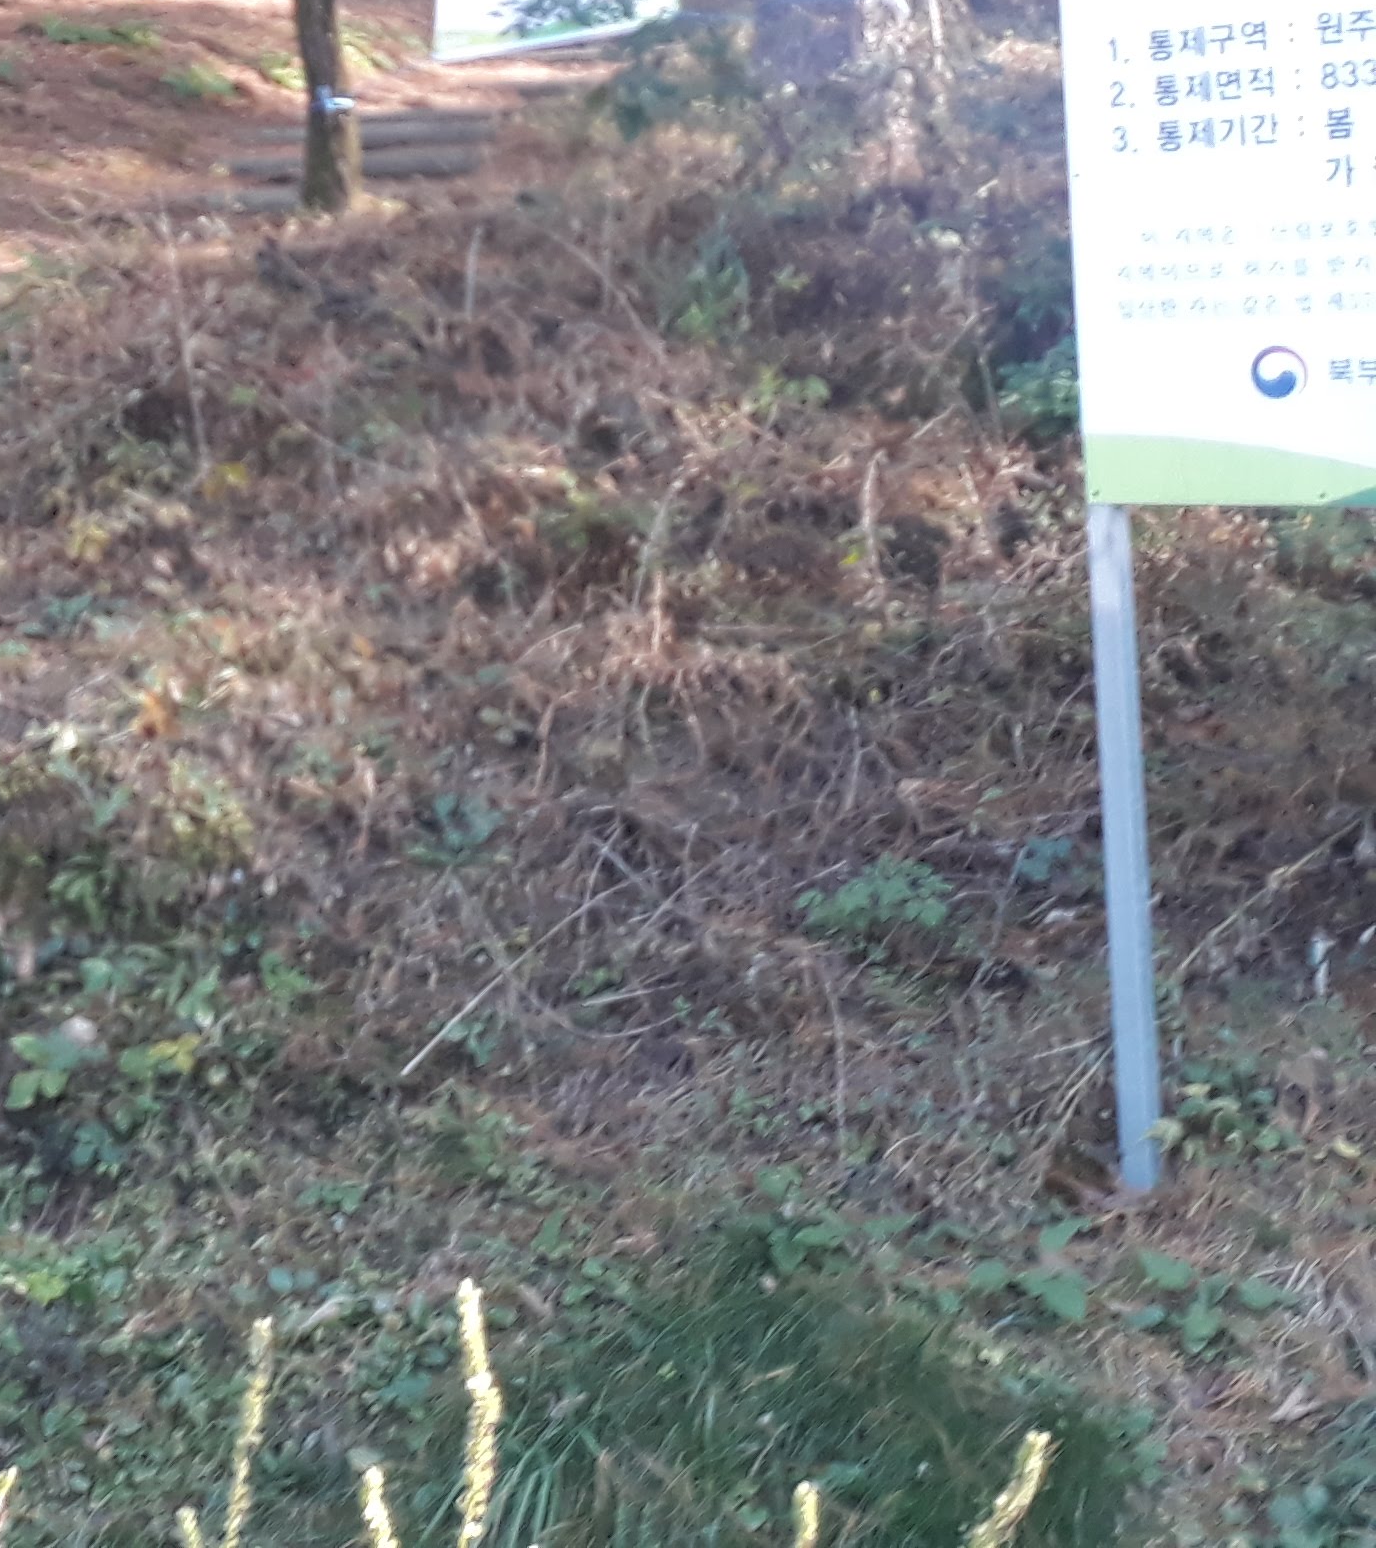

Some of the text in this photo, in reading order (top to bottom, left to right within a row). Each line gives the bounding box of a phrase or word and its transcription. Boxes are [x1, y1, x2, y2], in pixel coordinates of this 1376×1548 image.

[1108, 38, 1130, 64] 1.
[1148, 20, 1268, 62] 통제구역
[1315, 9, 1376, 44] 원주
[1109, 80, 1136, 109] 2.
[1154, 66, 1275, 107] 통제면적
[1112, 125, 1139, 153] 3.
[1157, 113, 1279, 153] 통제기간
[1324, 106, 1355, 140] 봄
